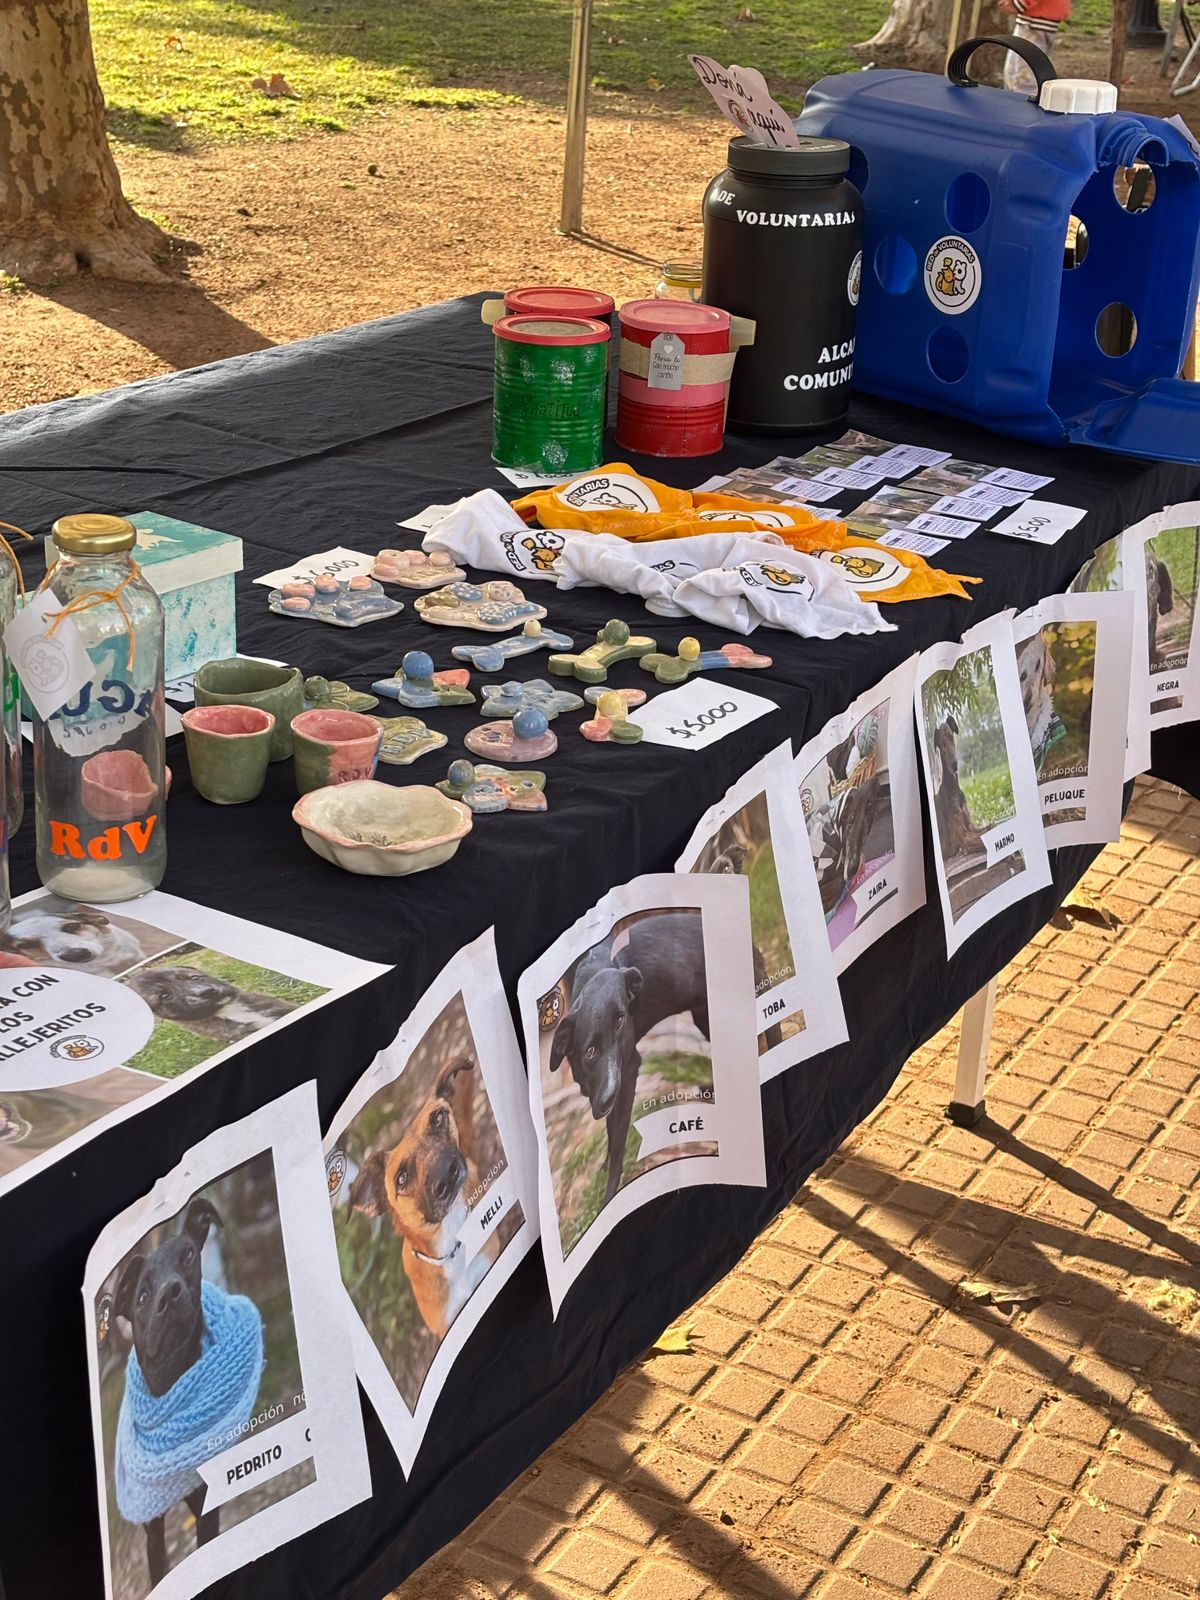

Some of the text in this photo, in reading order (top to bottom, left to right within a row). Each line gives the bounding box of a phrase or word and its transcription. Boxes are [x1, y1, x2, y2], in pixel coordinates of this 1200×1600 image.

[717, 190, 736, 206] DE
[937, 239, 976, 263] VOLUNTARIAS
[1007, 516, 1052, 539] $500
[1156, 680, 1180, 693] NEGRA
[665, 701, 738, 739] $5000
[1044, 788, 1086, 806] PELUQUE
[49, 814, 158, 861] RdV
[867, 878, 888, 901] ZAIRA
[12, 974, 60, 997] CON
[762, 998, 786, 1019] TOBA
[0, 1002, 106, 1061] LLEJERITOS
[642, 1098, 656, 1110] En
[669, 1116, 704, 1134] CAFÉ
[480, 1196, 503, 1230] MELLI
[206, 1436, 224, 1453] En
[225, 1402, 285, 1441] adopción
[226, 1444, 282, 1486] PEDRITO
